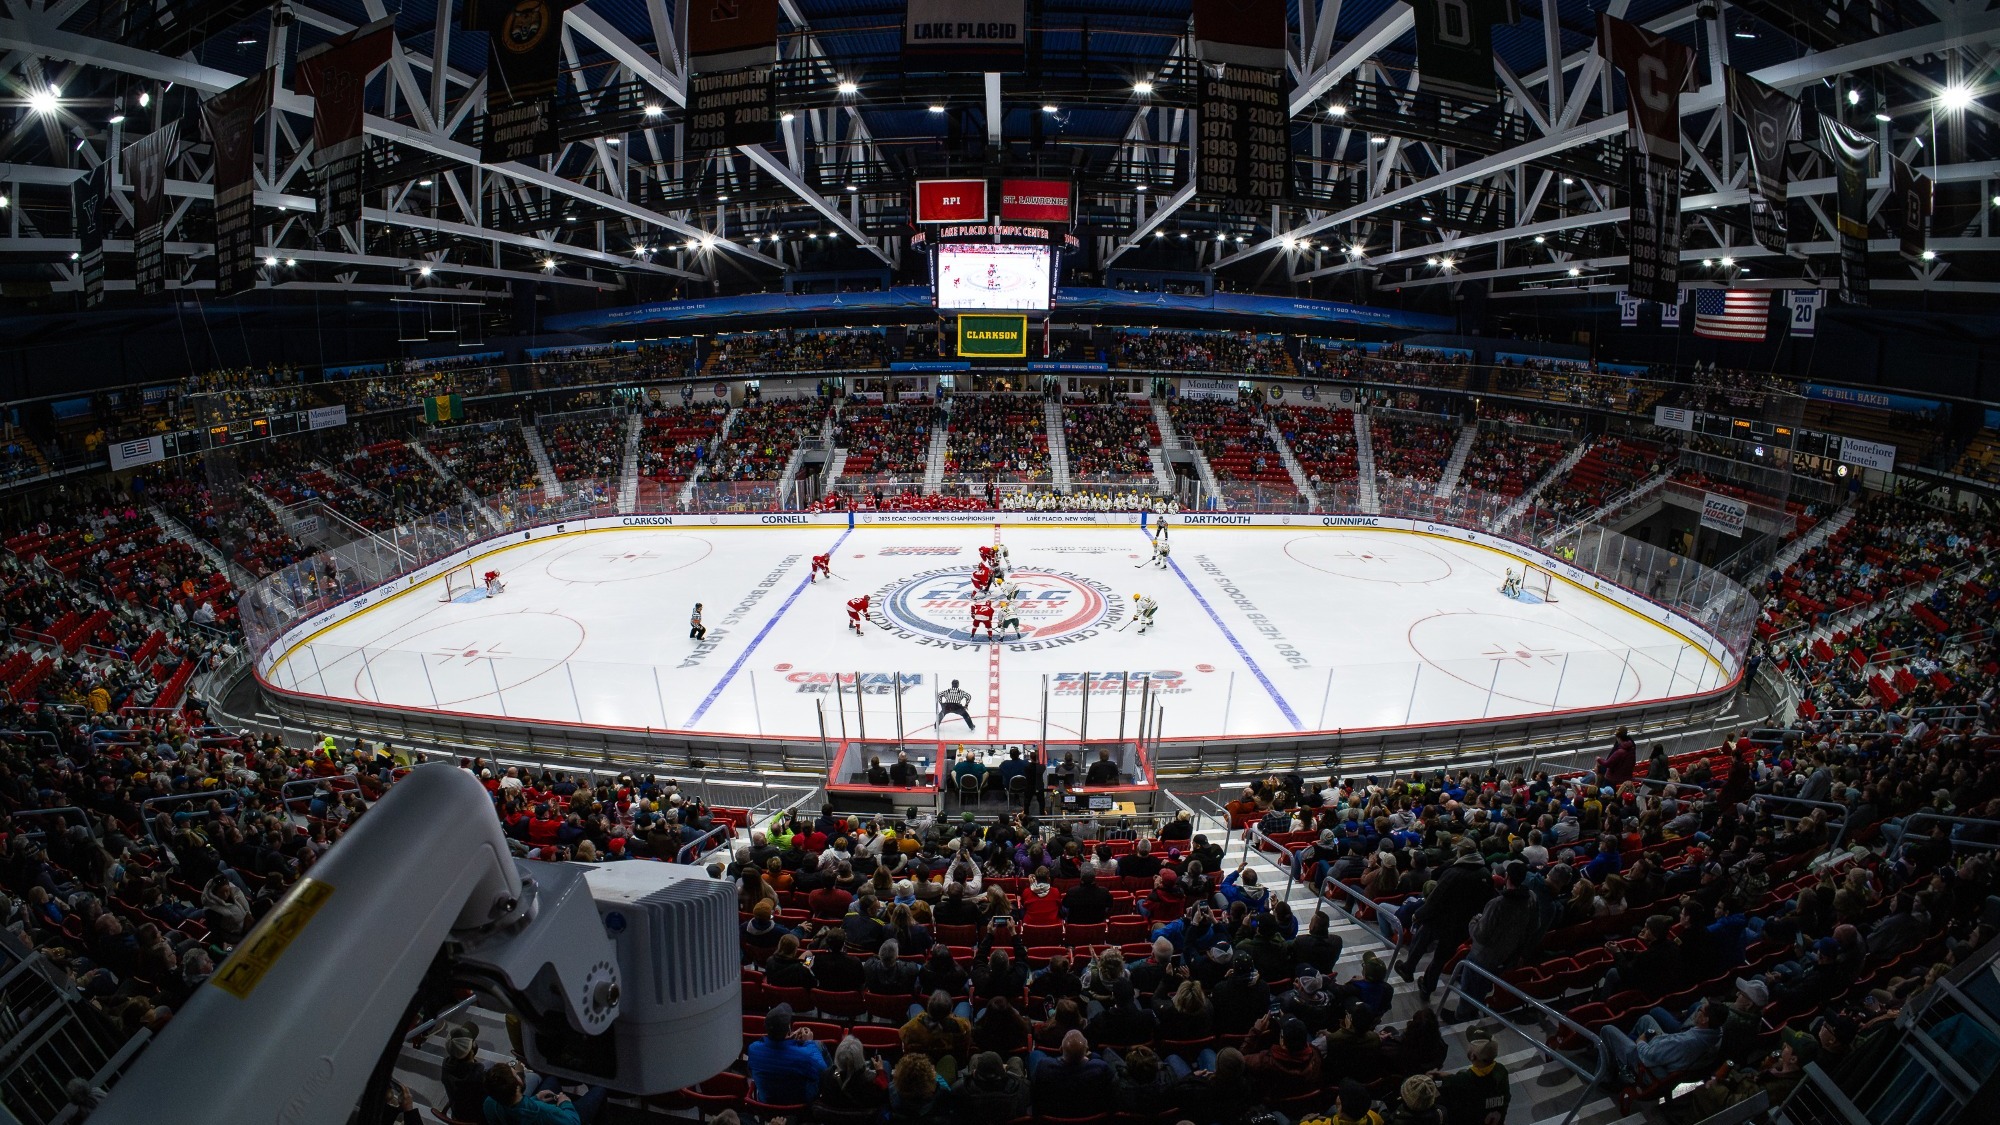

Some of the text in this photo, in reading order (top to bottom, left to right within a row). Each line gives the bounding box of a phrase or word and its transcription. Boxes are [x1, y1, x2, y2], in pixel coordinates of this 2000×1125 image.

[914, 22, 1016, 39] LAKE PLACID
[694, 70, 769, 93] TOURNAMENT
[1638, 54, 1668, 112] C
[698, 88, 767, 109] CHAMPIONS
[1208, 82, 1278, 106] CHAMPIONS
[692, 111, 725, 129] 1998
[1203, 102, 1284, 126] 1963 2002
[691, 130, 725, 147] 2018
[1203, 121, 1285, 145] 1971 2004
[1760, 122, 1775, 147] C
[507, 140, 533, 158] 2016
[1203, 140, 1287, 162] 1983 2006
[1203, 157, 1285, 179] 1987 2015
[1203, 175, 1283, 197] 1994 2017
[942, 197, 961, 206] RPI
[1003, 195, 1068, 207] ST. LAWRENCE
[1226, 198, 1263, 215] 2022
[940, 226, 1049, 240] LAKE PLACID OLYMPIC CENTER
[1293, 303, 1310, 311] HOME
[1623, 303, 1636, 317] 15
[1664, 304, 1677, 317] 16
[1795, 304, 1812, 322] 20
[966, 330, 1018, 341] CLARKSON
[1834, 389, 1855, 401] BILL
[1857, 393, 1889, 405] BAKER
[310, 409, 345, 420] Montefiore
[1842, 439, 1894, 461] Montefiore
[1841, 453, 1878, 468] Einstein
[1703, 507, 1744, 526] HOCKEY
[1705, 499, 1736, 516] ECAC
[622, 516, 673, 526] CLARKSON
[761, 515, 809, 525] CORNELL
[1183, 515, 1251, 525] DARTMOUTH
[1322, 517, 1379, 526] QUINNIPIAC
[1702, 515, 1743, 531] CHAMPIONSHIP
[758, 568, 789, 588] HERB
[1058, 570, 1112, 596] PLACID
[872, 576, 910, 608] OLYMPIC
[1214, 577, 1258, 611] BROOKS
[721, 589, 768, 626] BROOKS
[1097, 594, 1123, 631] OLYMPIC
[1247, 613, 1287, 640] HERB
[676, 627, 730, 669] ARENA
[915, 638, 982, 653] LAKE
[1008, 629, 1099, 653] CENTER
[1274, 643, 1312, 670] 1980
[1053, 671, 1151, 681] ECAC
[796, 683, 913, 695] HOCKEY
[1053, 680, 1187, 691] HOCKEY
